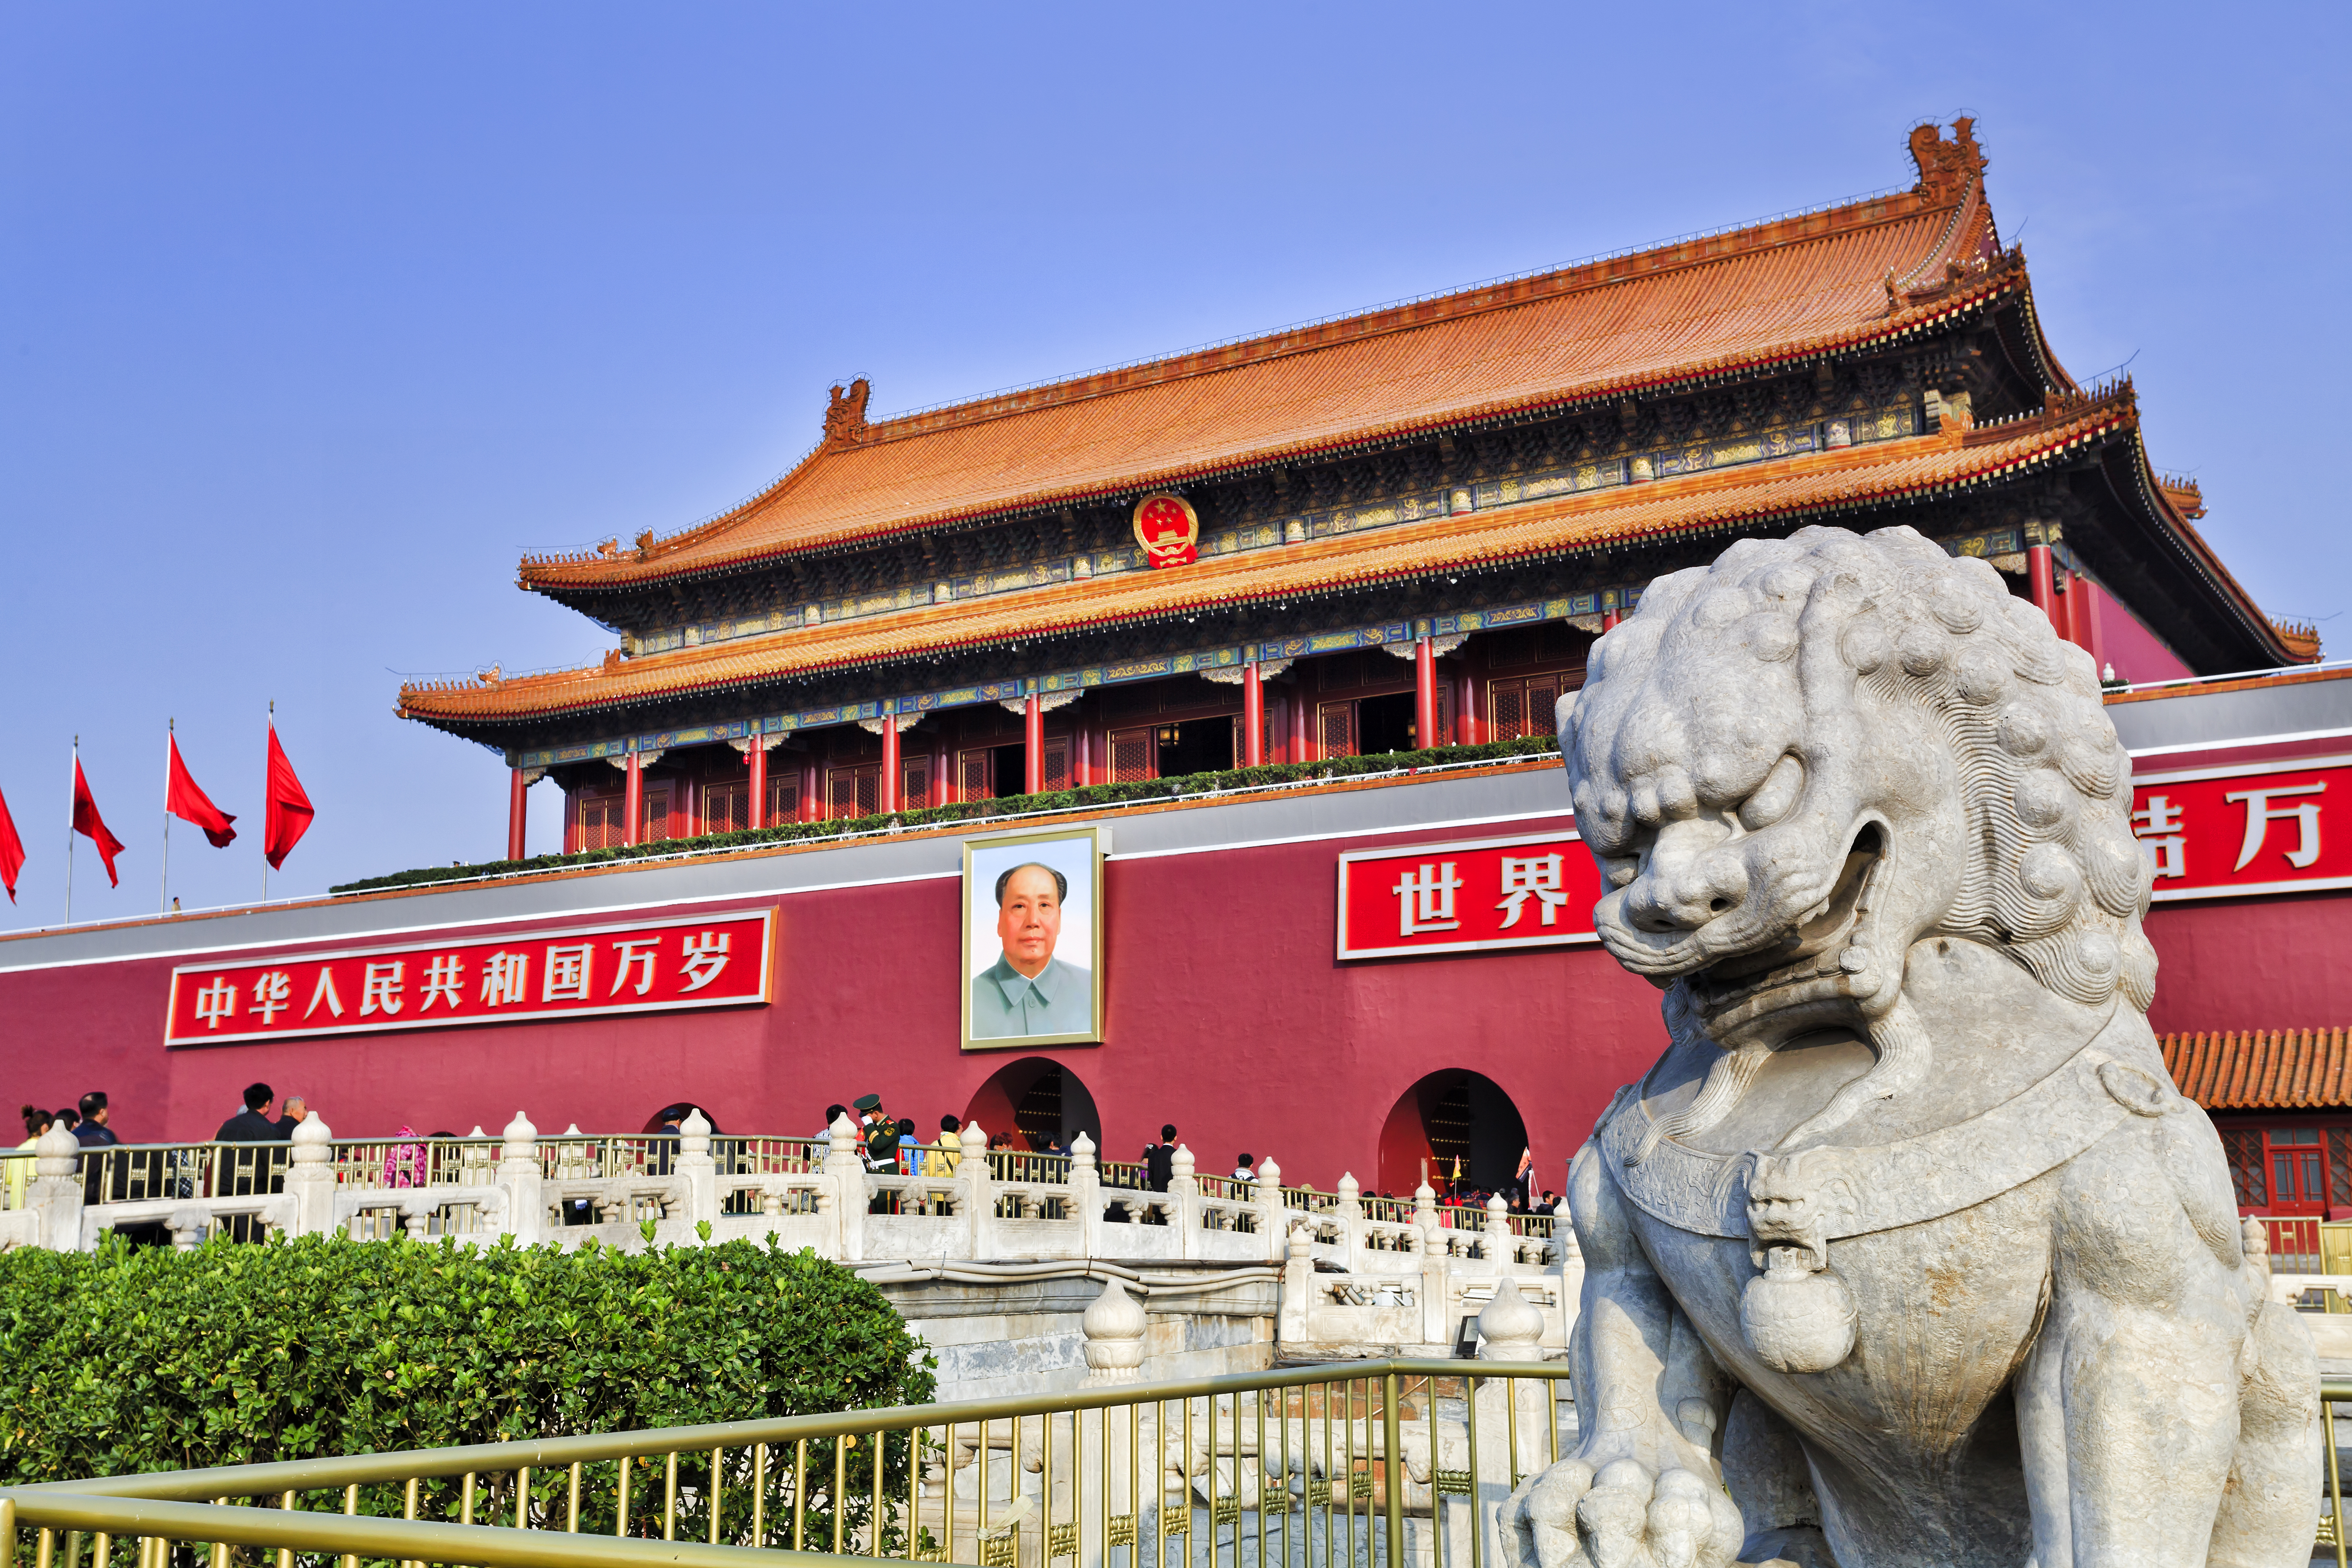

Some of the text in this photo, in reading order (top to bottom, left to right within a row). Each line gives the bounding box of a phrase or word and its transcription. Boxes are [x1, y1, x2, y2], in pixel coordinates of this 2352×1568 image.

[1392, 853, 1569, 936] 世界
[195, 931, 731, 1029] 中华人民共和国万岁
